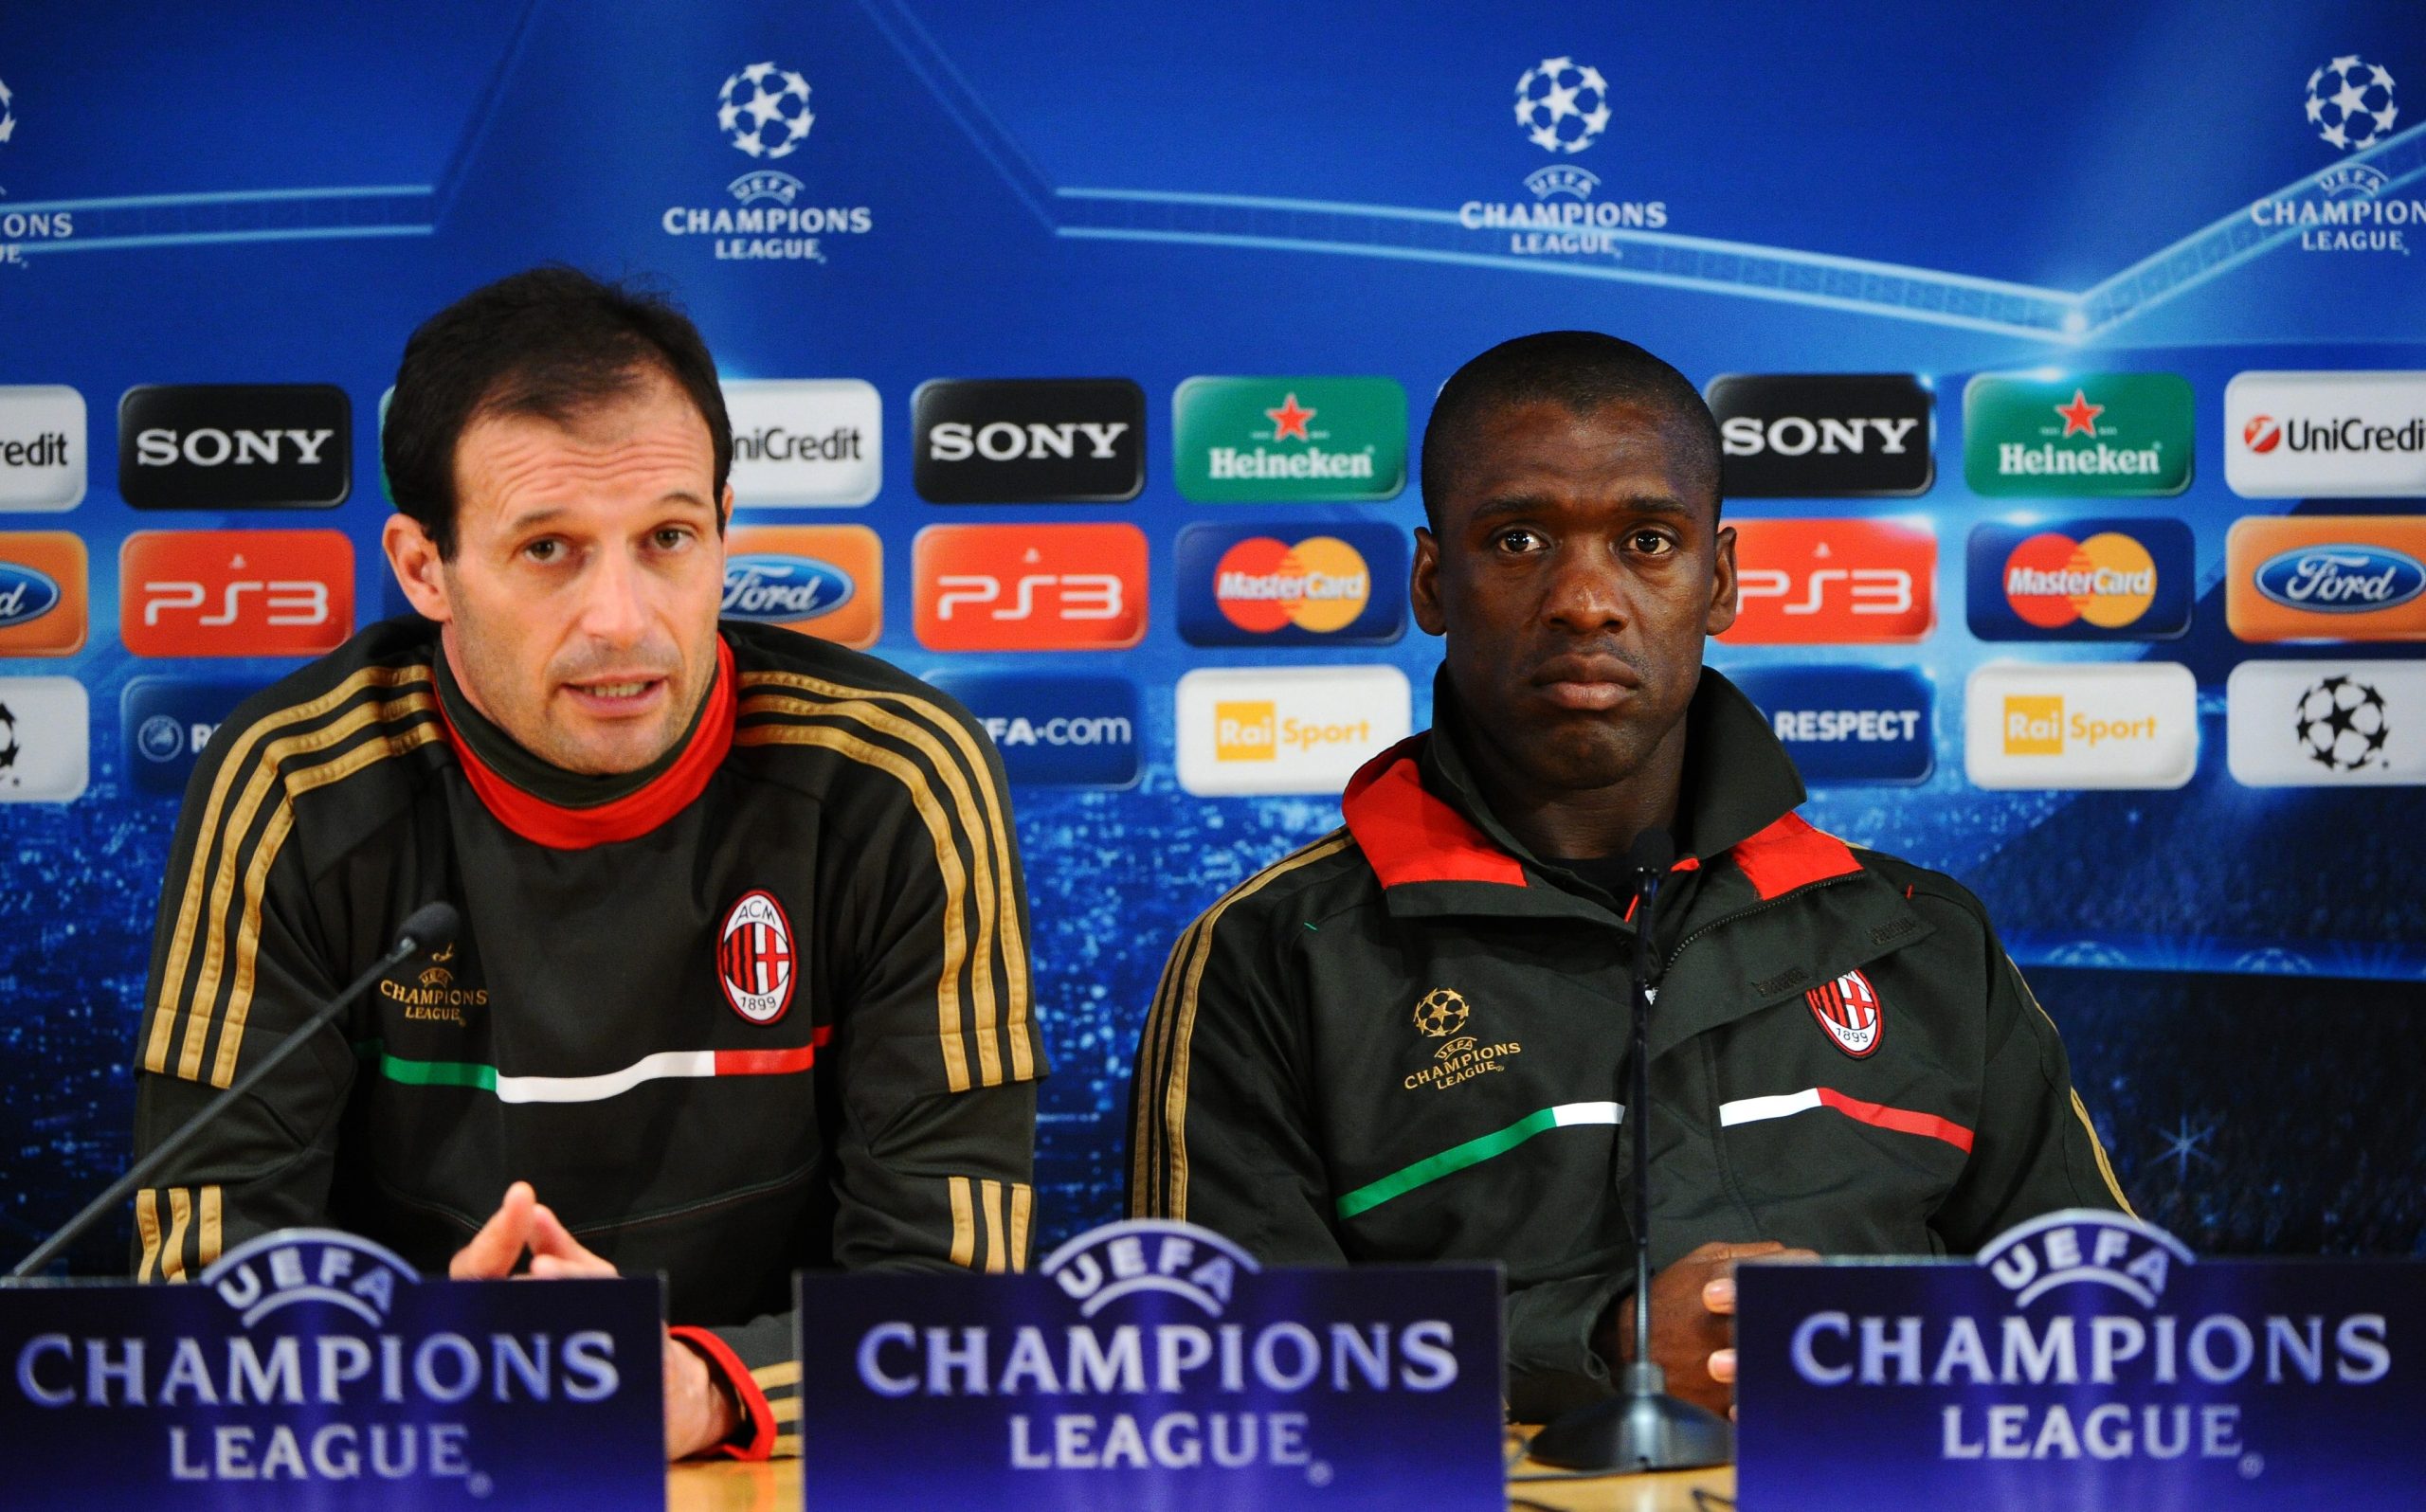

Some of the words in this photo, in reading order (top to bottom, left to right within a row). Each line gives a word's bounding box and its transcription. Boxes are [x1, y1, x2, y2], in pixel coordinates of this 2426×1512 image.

[662, 207, 873, 235] CHAMPIONS
[1459, 201, 1668, 229] CHAMPIONS
[715, 239, 821, 260] LEAGUE
[1511, 233, 1616, 254] LEAGUE
[2302, 229, 2405, 251] LEAGUE
[0, 432, 67, 466] edit
[136, 428, 334, 466] SONY
[930, 423, 1129, 460] SONY
[1721, 417, 1918, 456] SONY
[2288, 418, 2426, 452] UniCredi
[1209, 446, 1373, 478] Heineken
[1999, 442, 2161, 475] Heineken
[722, 566, 822, 611] Ford
[1218, 571, 1366, 599] MasterCard
[1736, 569, 1911, 614] PS3
[2007, 567, 2151, 596] MasterCard
[2286, 554, 2397, 601] Ford
[144, 582, 329, 626] PS3
[937, 575, 1123, 621] PS3
[1220, 715, 1273, 746] Rai
[1282, 716, 1370, 752] Sport
[1774, 711, 1921, 741] RESPECT
[2009, 711, 2060, 741] Rai
[2070, 712, 2156, 747] Sport
[735, 900, 776, 925] ACM
[380, 979, 489, 1005] CHAMPIONS
[740, 996, 777, 1012] 1899
[405, 1006, 462, 1020] LEAGUE
[1437, 1039, 1474, 1059] UEFA
[1837, 1027, 1869, 1043] 1899
[1404, 1042, 1521, 1089] CHAMPIONS
[1436, 1060, 1497, 1089] LEAGUE
[1055, 1233, 1233, 1305] UEFA
[1991, 1227, 2170, 1294] UEFA
[217, 1246, 395, 1315] UEFA
[857, 1320, 1459, 1397] CHAMPIONS
[1790, 1311, 2392, 1386] CHAMPIONS
[16, 1330, 621, 1408] CHAMPIONS
[1010, 1412, 1312, 1469] LEAGUE
[1942, 1404, 2242, 1460] LEAGUE
[169, 1423, 472, 1481] LEAGUE
